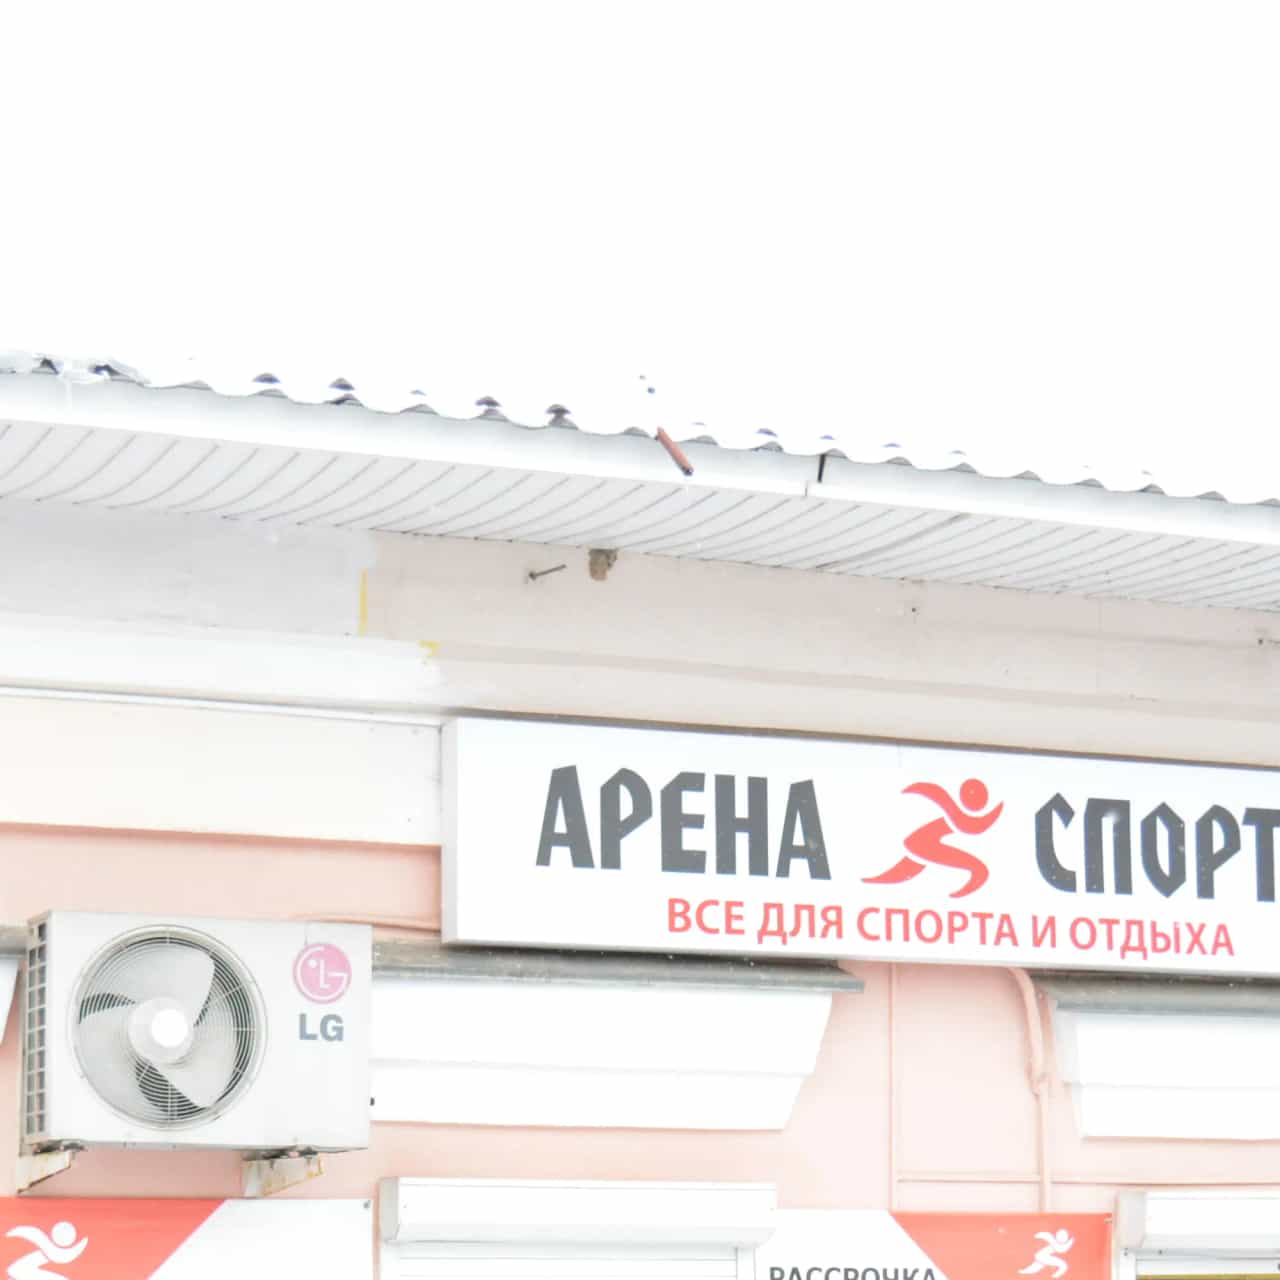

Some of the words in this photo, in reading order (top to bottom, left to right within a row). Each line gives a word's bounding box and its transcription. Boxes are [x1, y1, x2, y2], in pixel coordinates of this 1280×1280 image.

[535, 764, 832, 881] АРЕНА
[667, 897, 746, 936] ВСЕ
[756, 901, 844, 946] ДЛЯ
[856, 906, 1020, 948] СПОРТА
[1031, 915, 1057, 949] И
[1069, 916, 1235, 961] ОТДЫХА
[298, 1012, 345, 1042] LG
